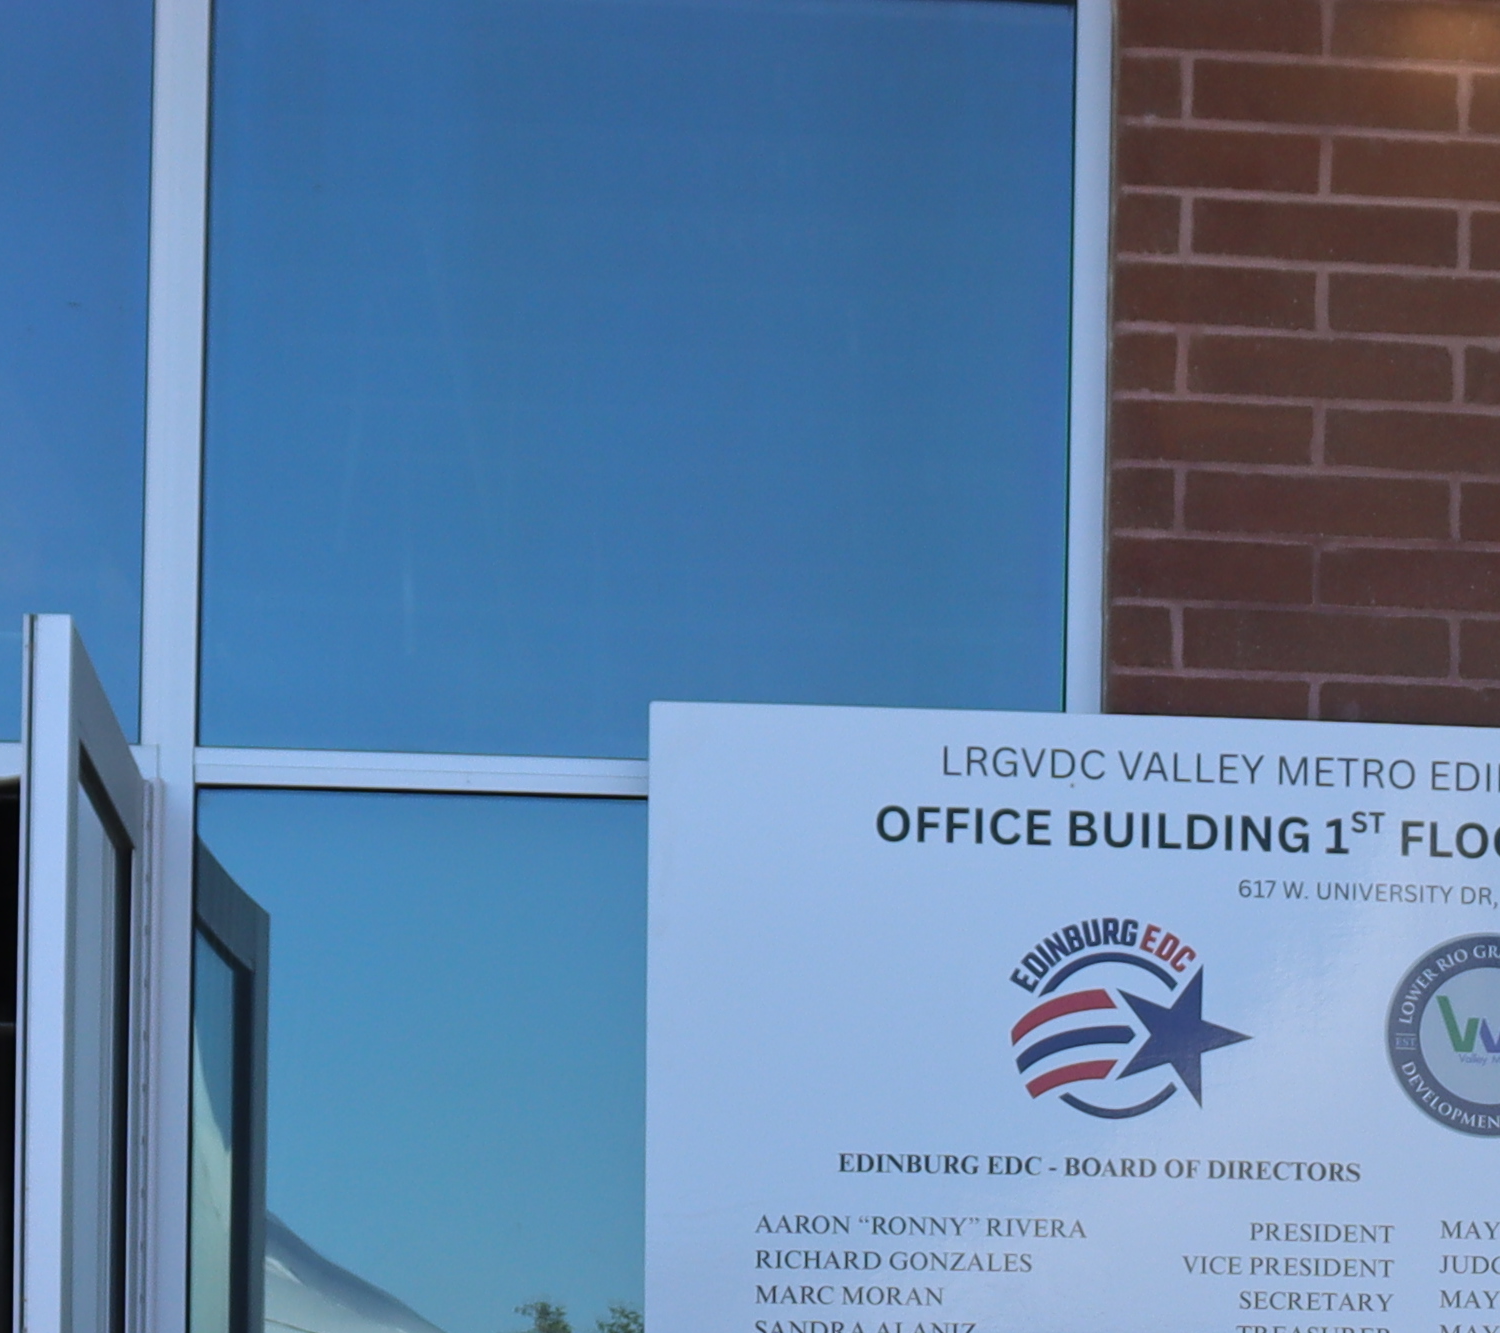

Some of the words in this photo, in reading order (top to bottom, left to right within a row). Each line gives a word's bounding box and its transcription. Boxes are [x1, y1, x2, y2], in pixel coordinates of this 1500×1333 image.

[942, 744, 1106, 781] LRGVDC
[1117, 750, 1265, 785] VALLEY
[1277, 755, 1417, 791] METRO
[875, 804, 1053, 847] OFFICE
[1068, 809, 1311, 855] BUILDING
[1324, 810, 1386, 856] 1ST
[1238, 878, 1277, 899] 617
[1282, 880, 1309, 900] W.
[1316, 881, 1454, 904] UNIVERSITY
[1460, 885, 1499, 910] DR,
[1009, 917, 1138, 993] EDINBURG
[1139, 924, 1196, 973] EDC
[1398, 969, 1438, 1025] LOWER
[1436, 948, 1468, 973] RIO
[1459, 1053, 1487, 1066] Valley
[838, 1152, 980, 1176] EDINBURG
[987, 1155, 1043, 1176] EDC
[1064, 1156, 1158, 1179] BOARD
[1163, 1158, 1201, 1179] OF
[1207, 1159, 1362, 1183] DIRECTORS
[755, 1214, 851, 1235] AARON
[986, 1217, 1087, 1239] RIVERA
[1250, 1222, 1395, 1244] PRESIDENT
[755, 1249, 883, 1271] RICHARD
[888, 1251, 1033, 1273] GONZALES
[1182, 1255, 1242, 1276] VICE
[1249, 1256, 1395, 1279] PRESIDENT
[755, 1284, 835, 1306] MARC
[842, 1285, 943, 1306] MORAN
[1239, 1290, 1394, 1313] SECRETARY
